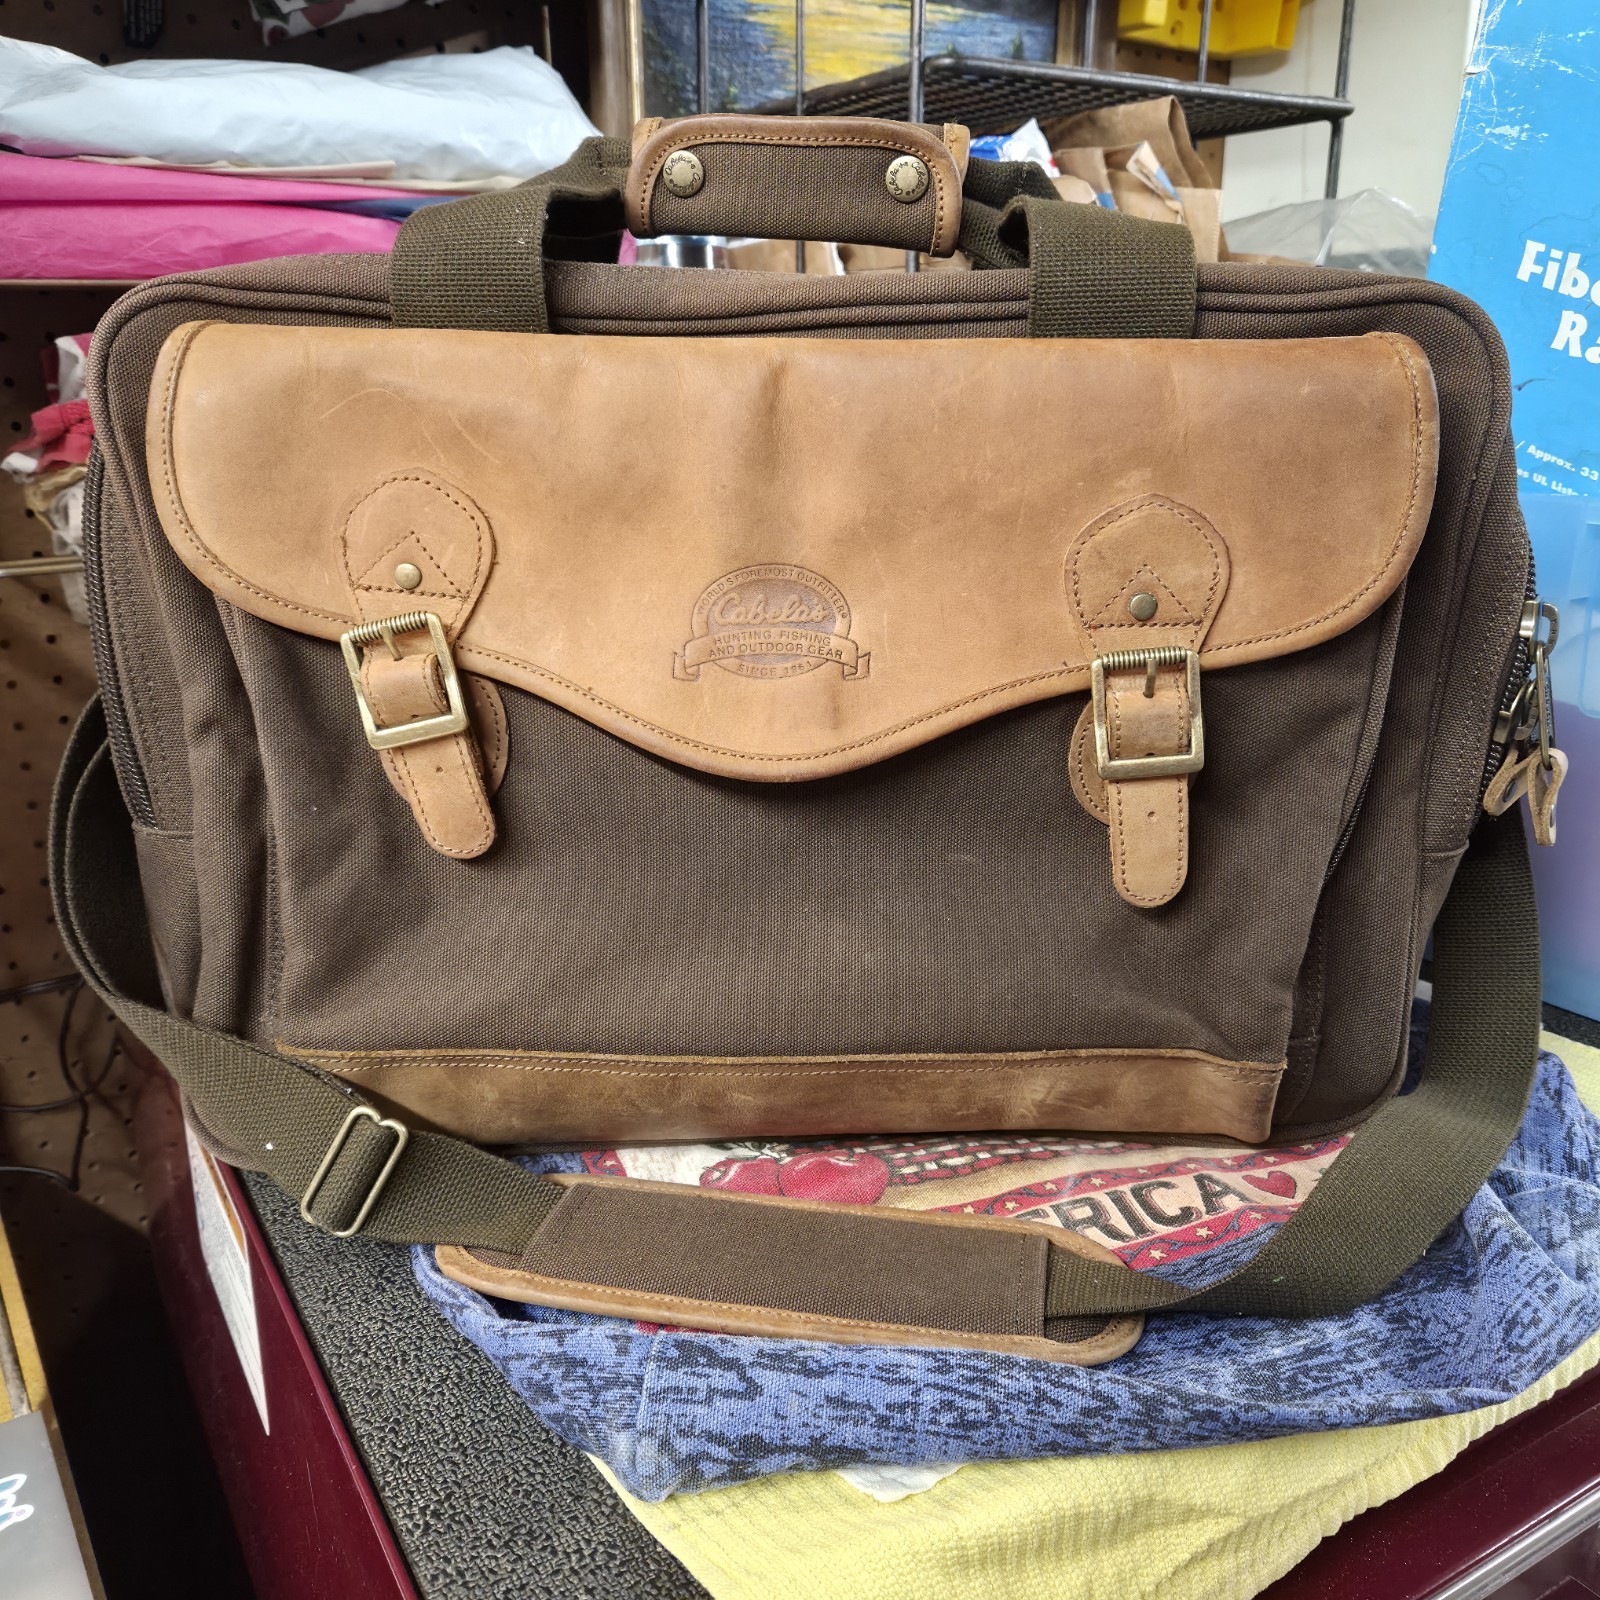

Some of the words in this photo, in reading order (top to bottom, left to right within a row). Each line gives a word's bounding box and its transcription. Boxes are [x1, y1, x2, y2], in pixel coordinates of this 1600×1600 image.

[1527, 444, 1576, 471] Approx.
[1580, 466, 1599, 480] 33
[709, 645, 735, 658] AND
[739, 642, 803, 655] OUTDOOR
[808, 644, 843, 660] GEAR
[780, 630, 831, 646] FISHING
[1014, 1173, 1255, 1243] RICA
